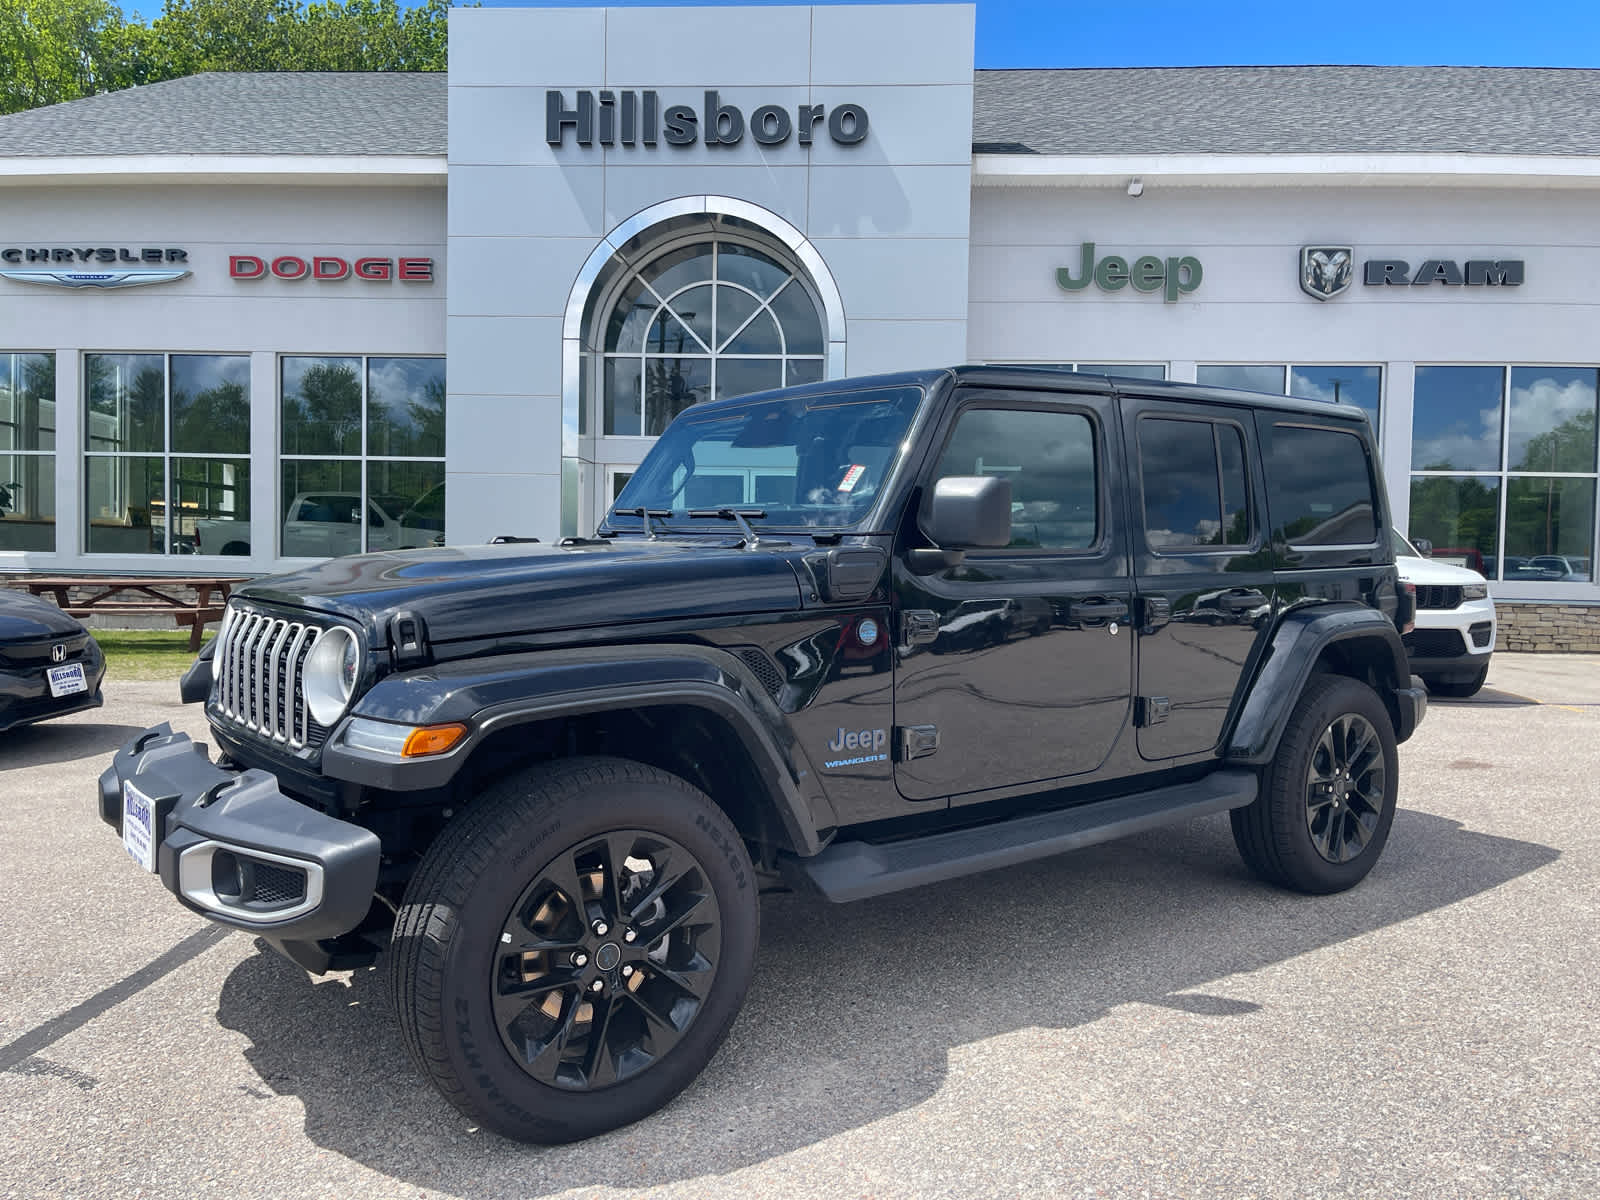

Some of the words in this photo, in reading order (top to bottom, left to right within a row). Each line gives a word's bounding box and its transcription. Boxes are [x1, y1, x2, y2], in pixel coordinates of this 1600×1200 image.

[545, 90, 870, 148] Hillsboro
[1, 248, 188, 263] CHRYSLER
[229, 256, 433, 281] DODGE
[1056, 242, 1203, 304] Jeep
[1363, 259, 1525, 287] RAM
[828, 727, 886, 752] Jeep
[824, 755, 878, 768] WRANGLER
[695, 814, 746, 888] NEXEN
